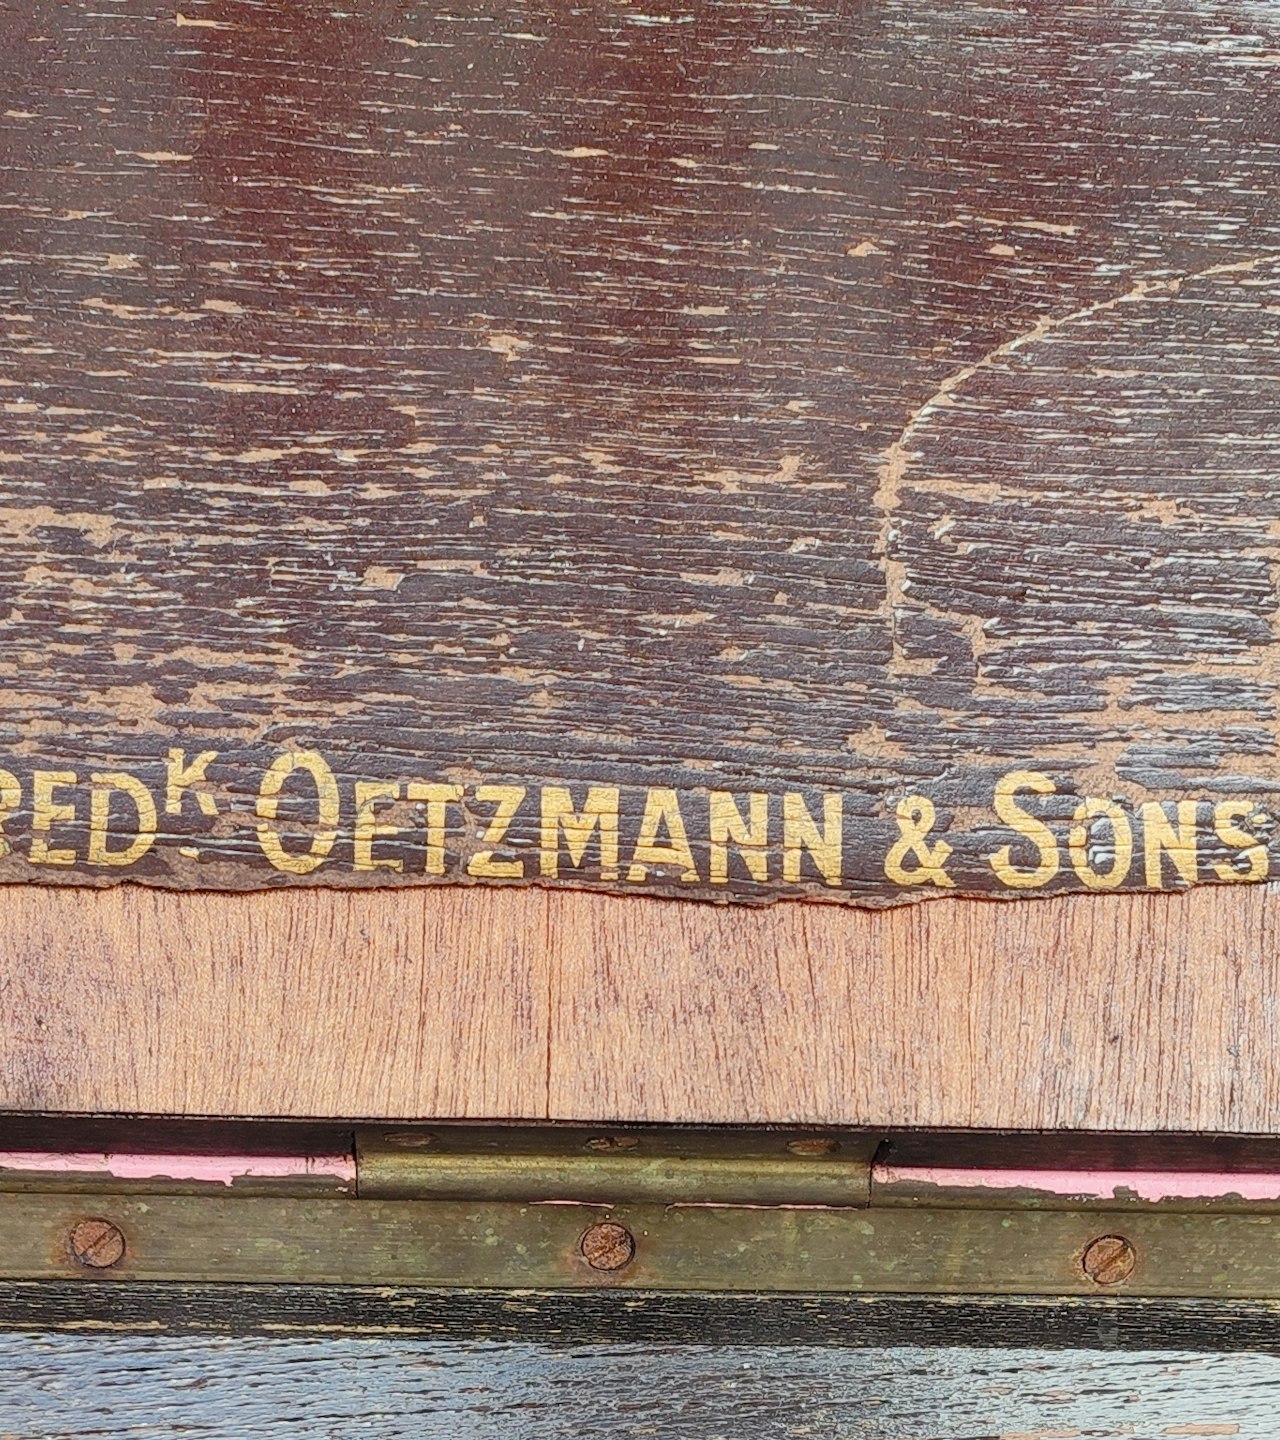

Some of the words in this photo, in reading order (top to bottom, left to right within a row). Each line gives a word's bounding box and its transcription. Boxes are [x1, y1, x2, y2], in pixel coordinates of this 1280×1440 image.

[256, 751, 843, 885] OETZMANN
[883, 795, 957, 888] &
[988, 770, 1271, 889] SONS
